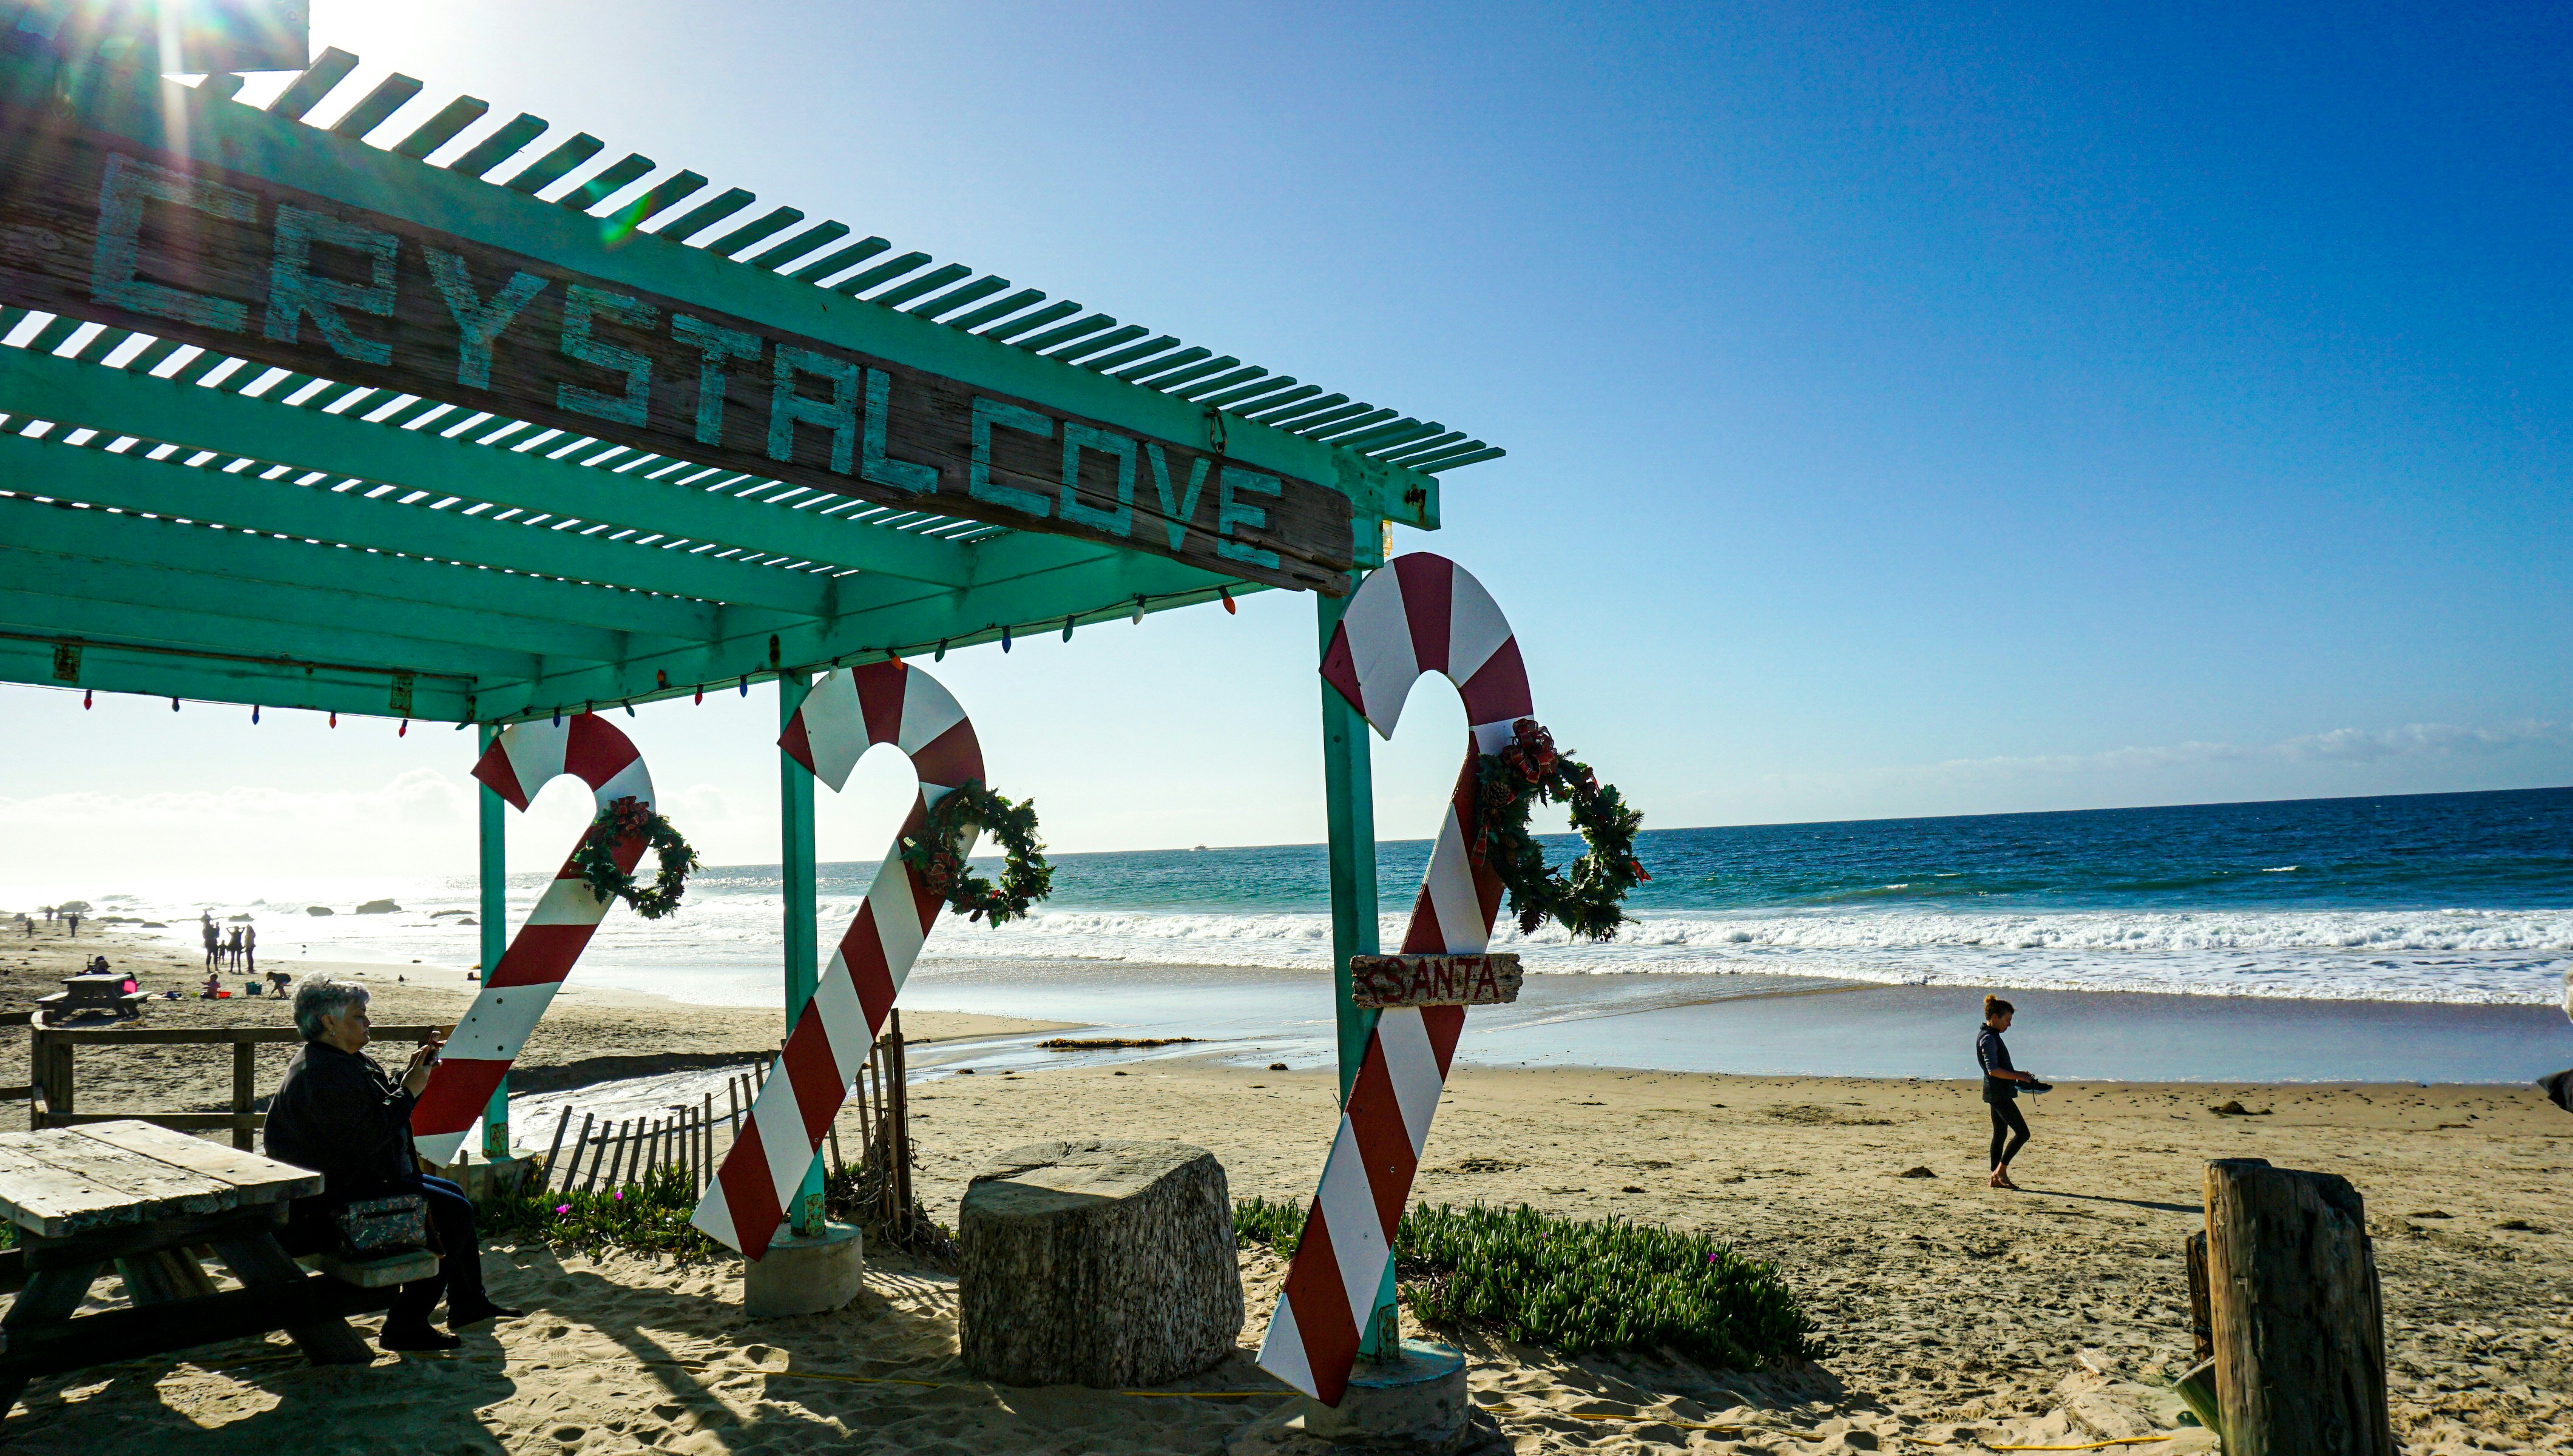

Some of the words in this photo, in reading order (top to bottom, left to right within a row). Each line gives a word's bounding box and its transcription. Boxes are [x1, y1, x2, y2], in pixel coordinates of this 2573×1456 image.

[90, 151, 939, 495] CRYSTAL
[969, 396, 1282, 570] COVE
[1381, 955, 1501, 1002] SANTA
